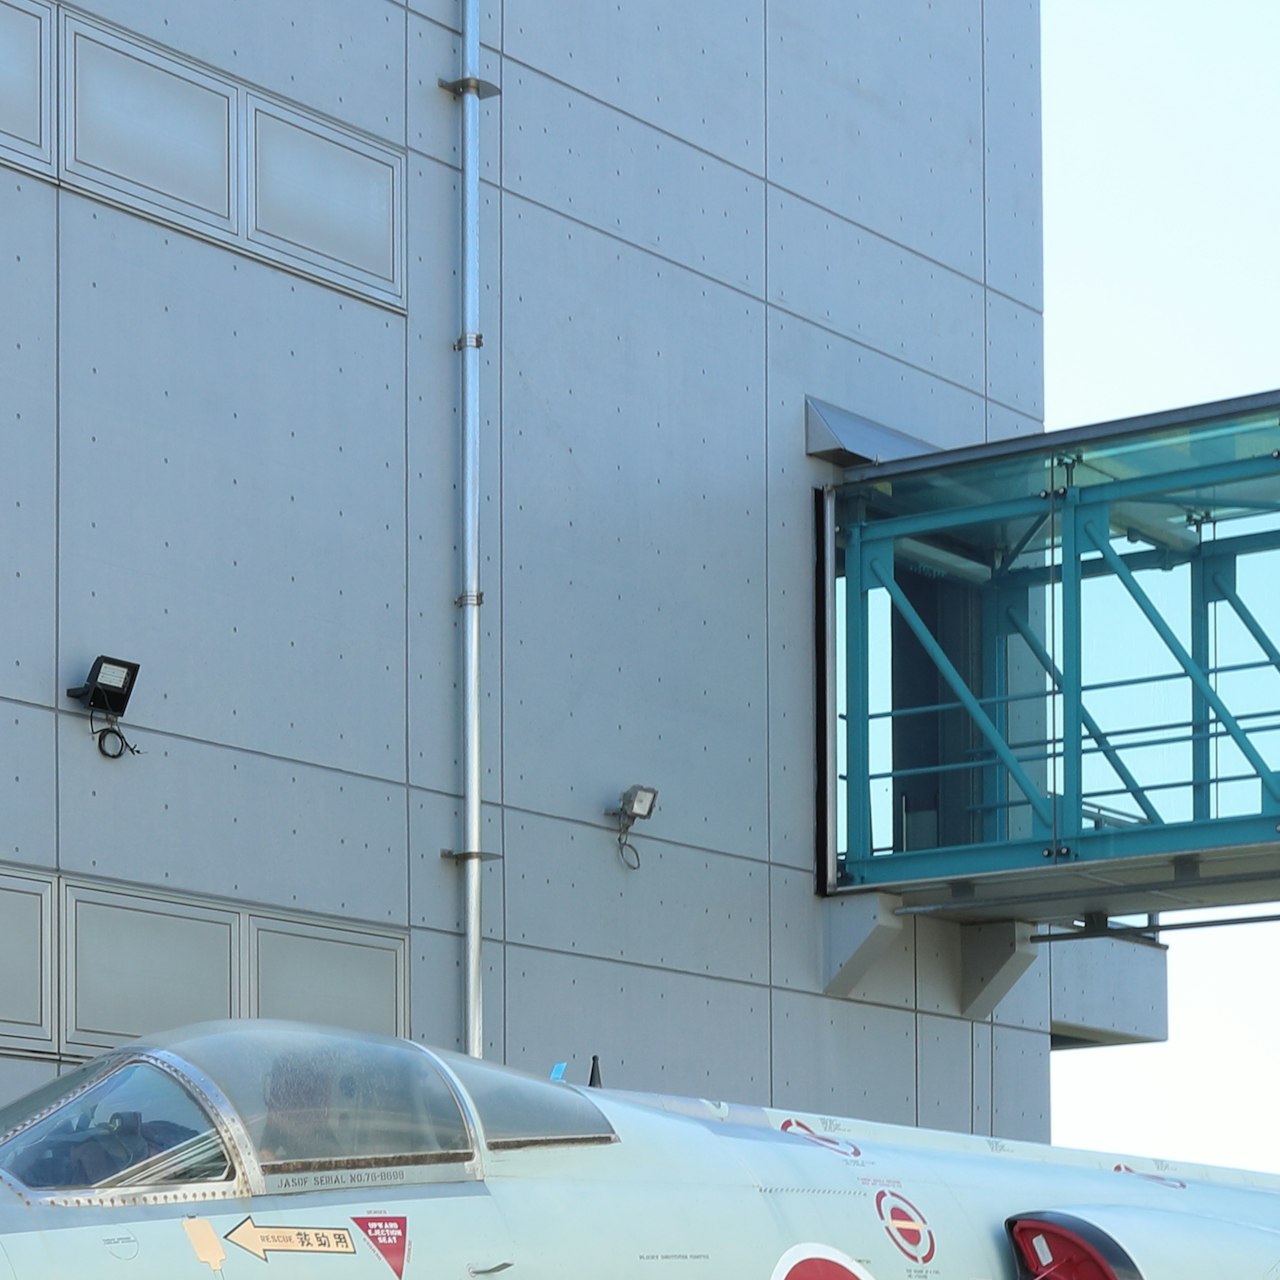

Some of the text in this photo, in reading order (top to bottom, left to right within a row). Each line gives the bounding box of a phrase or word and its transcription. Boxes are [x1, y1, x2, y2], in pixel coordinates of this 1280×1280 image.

[277, 1177, 309, 1189] JASDF
[313, 1174, 346, 1186] SERIAL
[368, 1229, 403, 1237] EJECTION
[260, 1234, 295, 1244] RESCUE
[377, 1236, 398, 1244] SEAT
